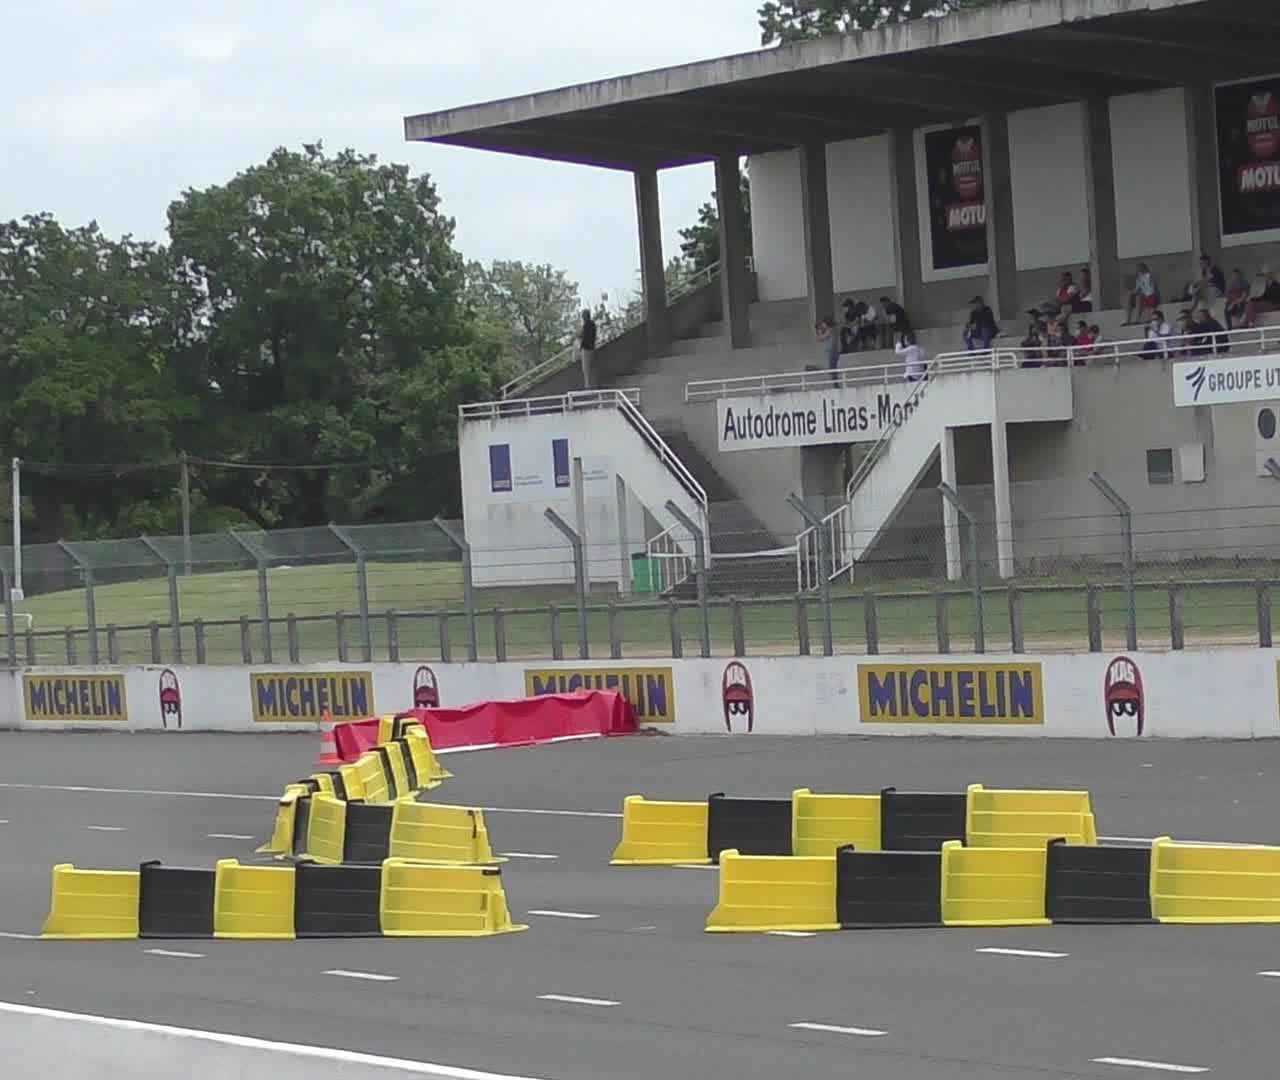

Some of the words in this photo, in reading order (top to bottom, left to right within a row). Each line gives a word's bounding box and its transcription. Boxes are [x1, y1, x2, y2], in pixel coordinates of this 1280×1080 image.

[946, 204, 986, 228] MOTU
[1208, 369, 1262, 392] GROUPE
[723, 405, 817, 441] Autodrome
[29, 679, 122, 716] MICHELIN
[257, 677, 368, 717] MICHELIN
[867, 669, 1034, 718] MICHELIN
